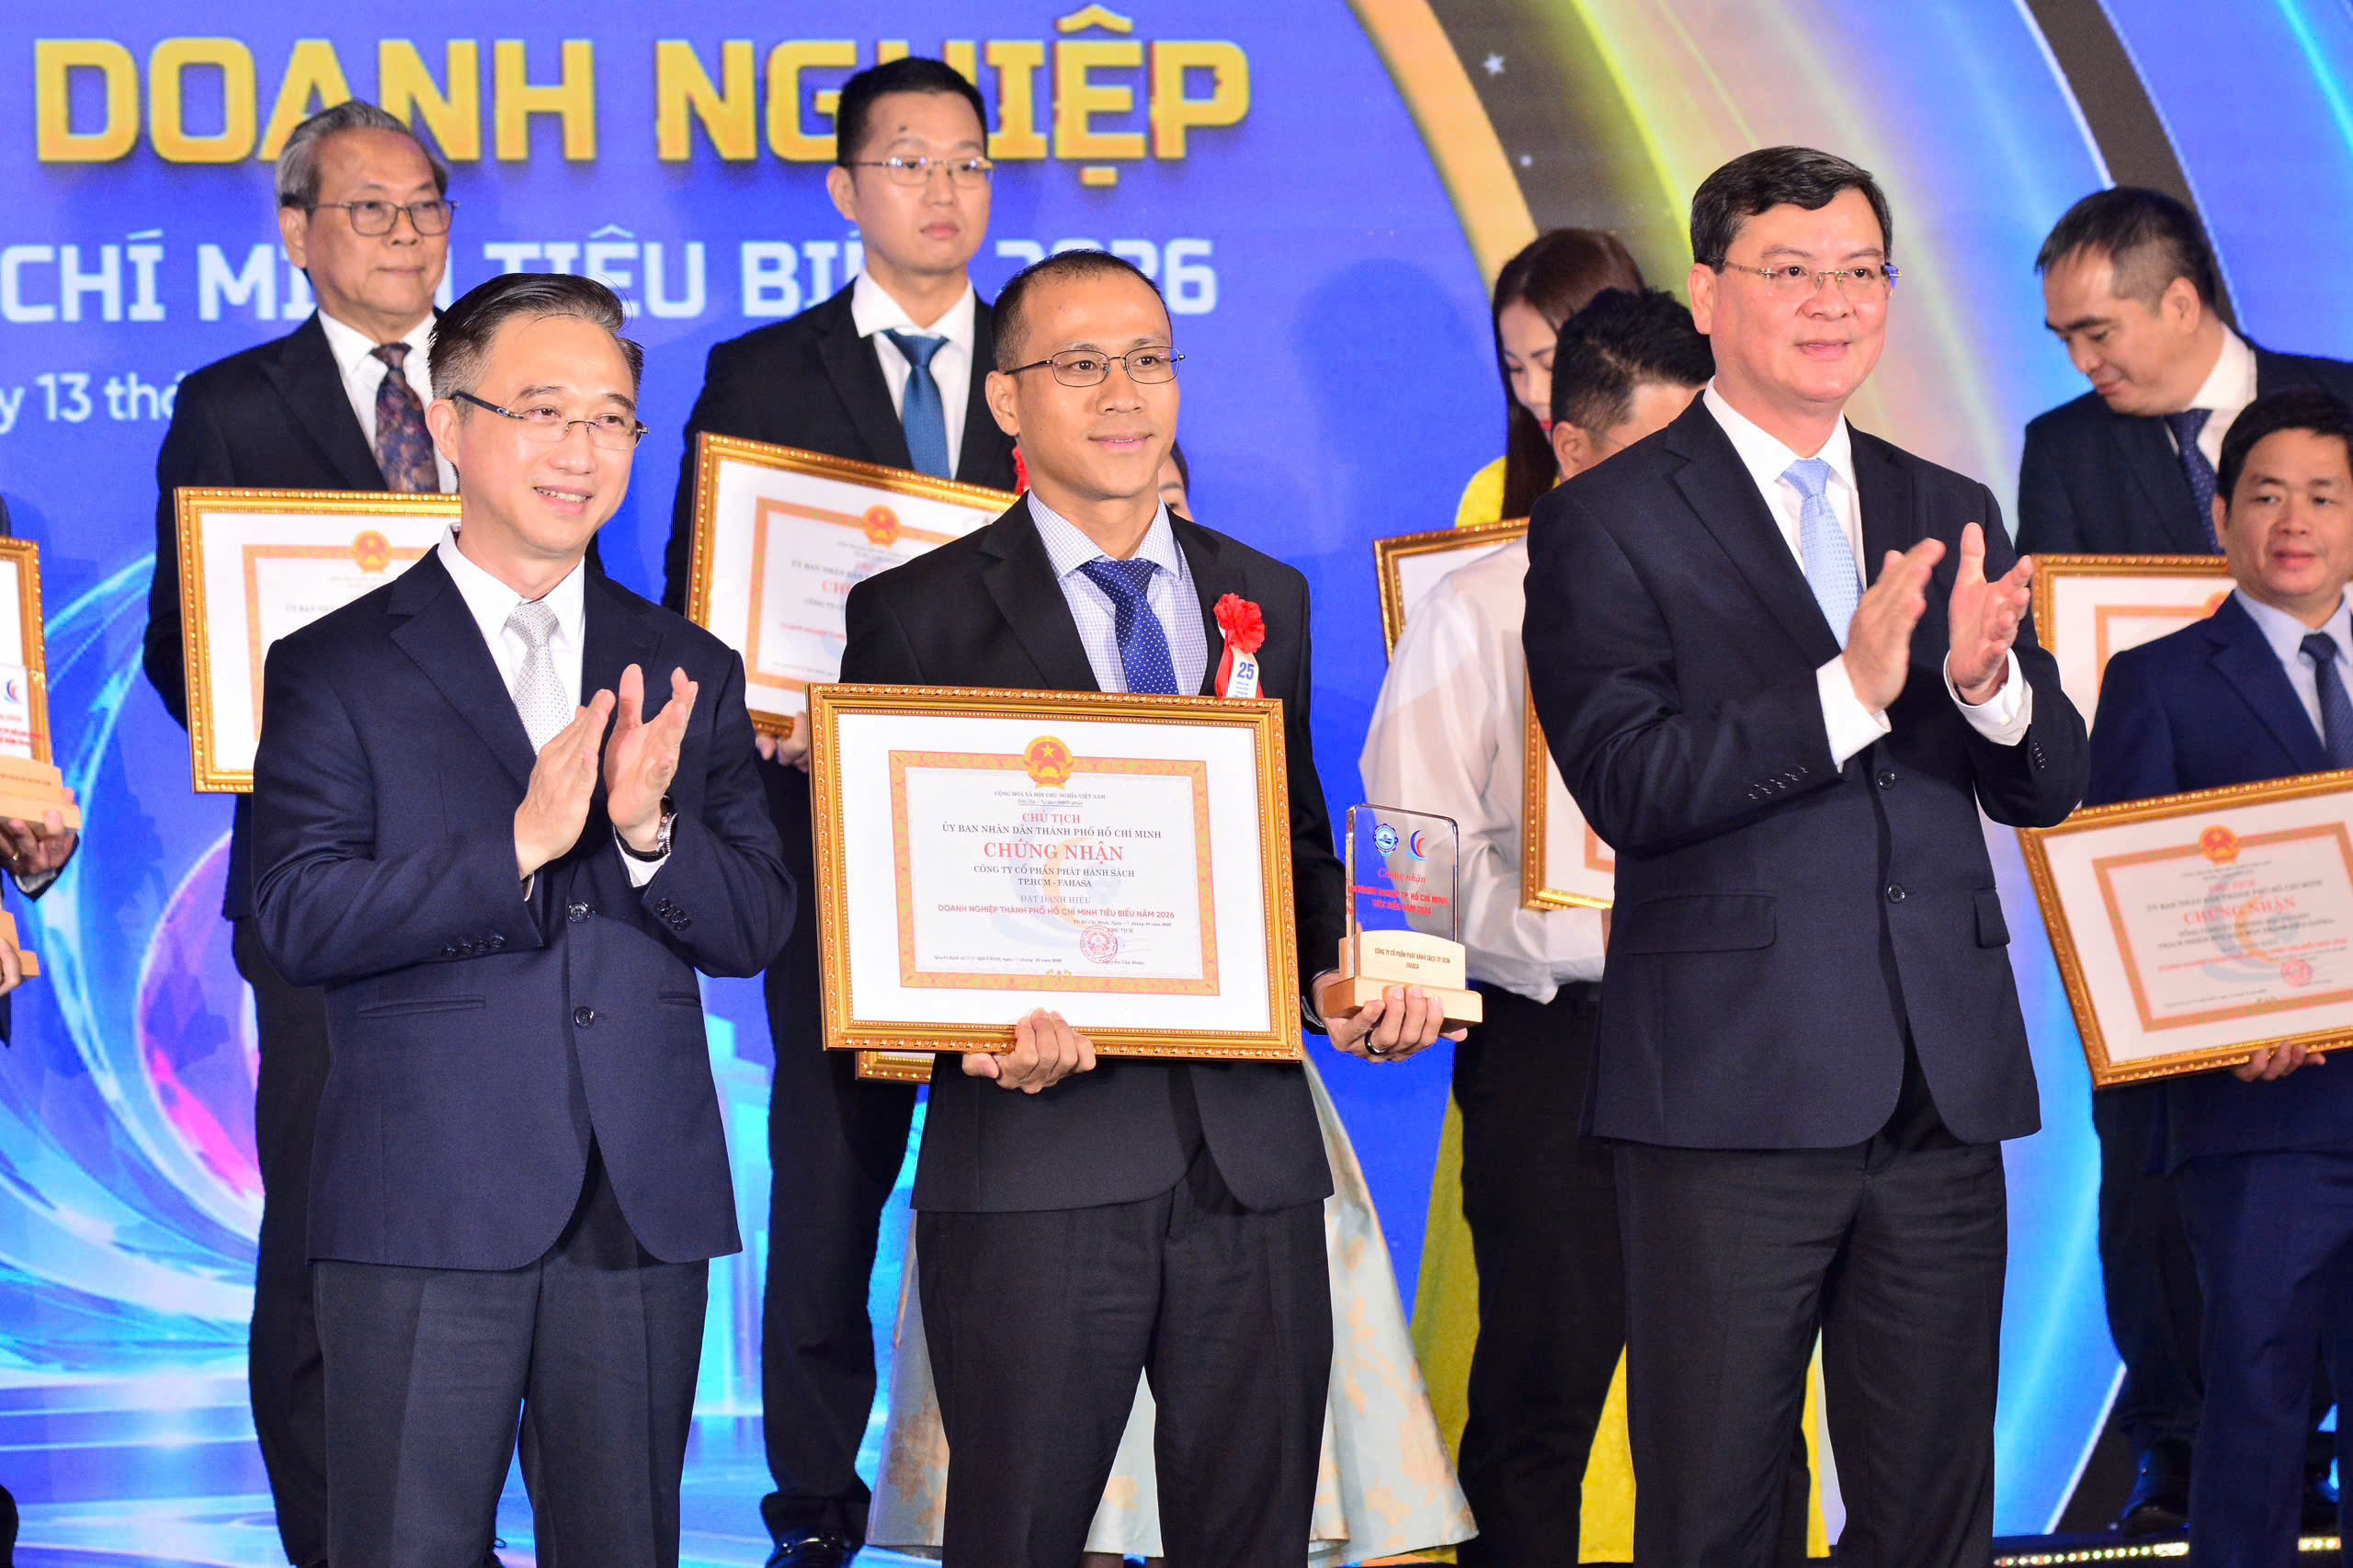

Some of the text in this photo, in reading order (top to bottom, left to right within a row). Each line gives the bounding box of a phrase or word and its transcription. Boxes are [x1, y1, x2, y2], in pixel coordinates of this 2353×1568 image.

[35, 37, 596, 163] DOANH
[1, 229, 165, 322] CHÍ
[35, 372, 92, 423] 13
[1237, 662, 1254, 680] 25
[1022, 810, 1081, 824] CHỦ TỊCH
[942, 821, 955, 832] ỦY
[959, 824, 978, 833] BAN
[982, 824, 1009, 834] NHÂN
[1013, 824, 1033, 835] DÂN
[1074, 826, 1095, 836] PHỐ
[1114, 828, 1131, 837] CHÍ
[1135, 830, 1161, 838] MINH
[984, 838, 1123, 864] CHỨNG NHẬN
[973, 863, 999, 873] CÔNG
[1110, 867, 1134, 877] SÁCH
[1058, 880, 1092, 888] FAHASA
[938, 904, 967, 913] DOANH
[970, 904, 998, 915] NGHIỆP
[1099, 907, 1116, 916] TIÊU
